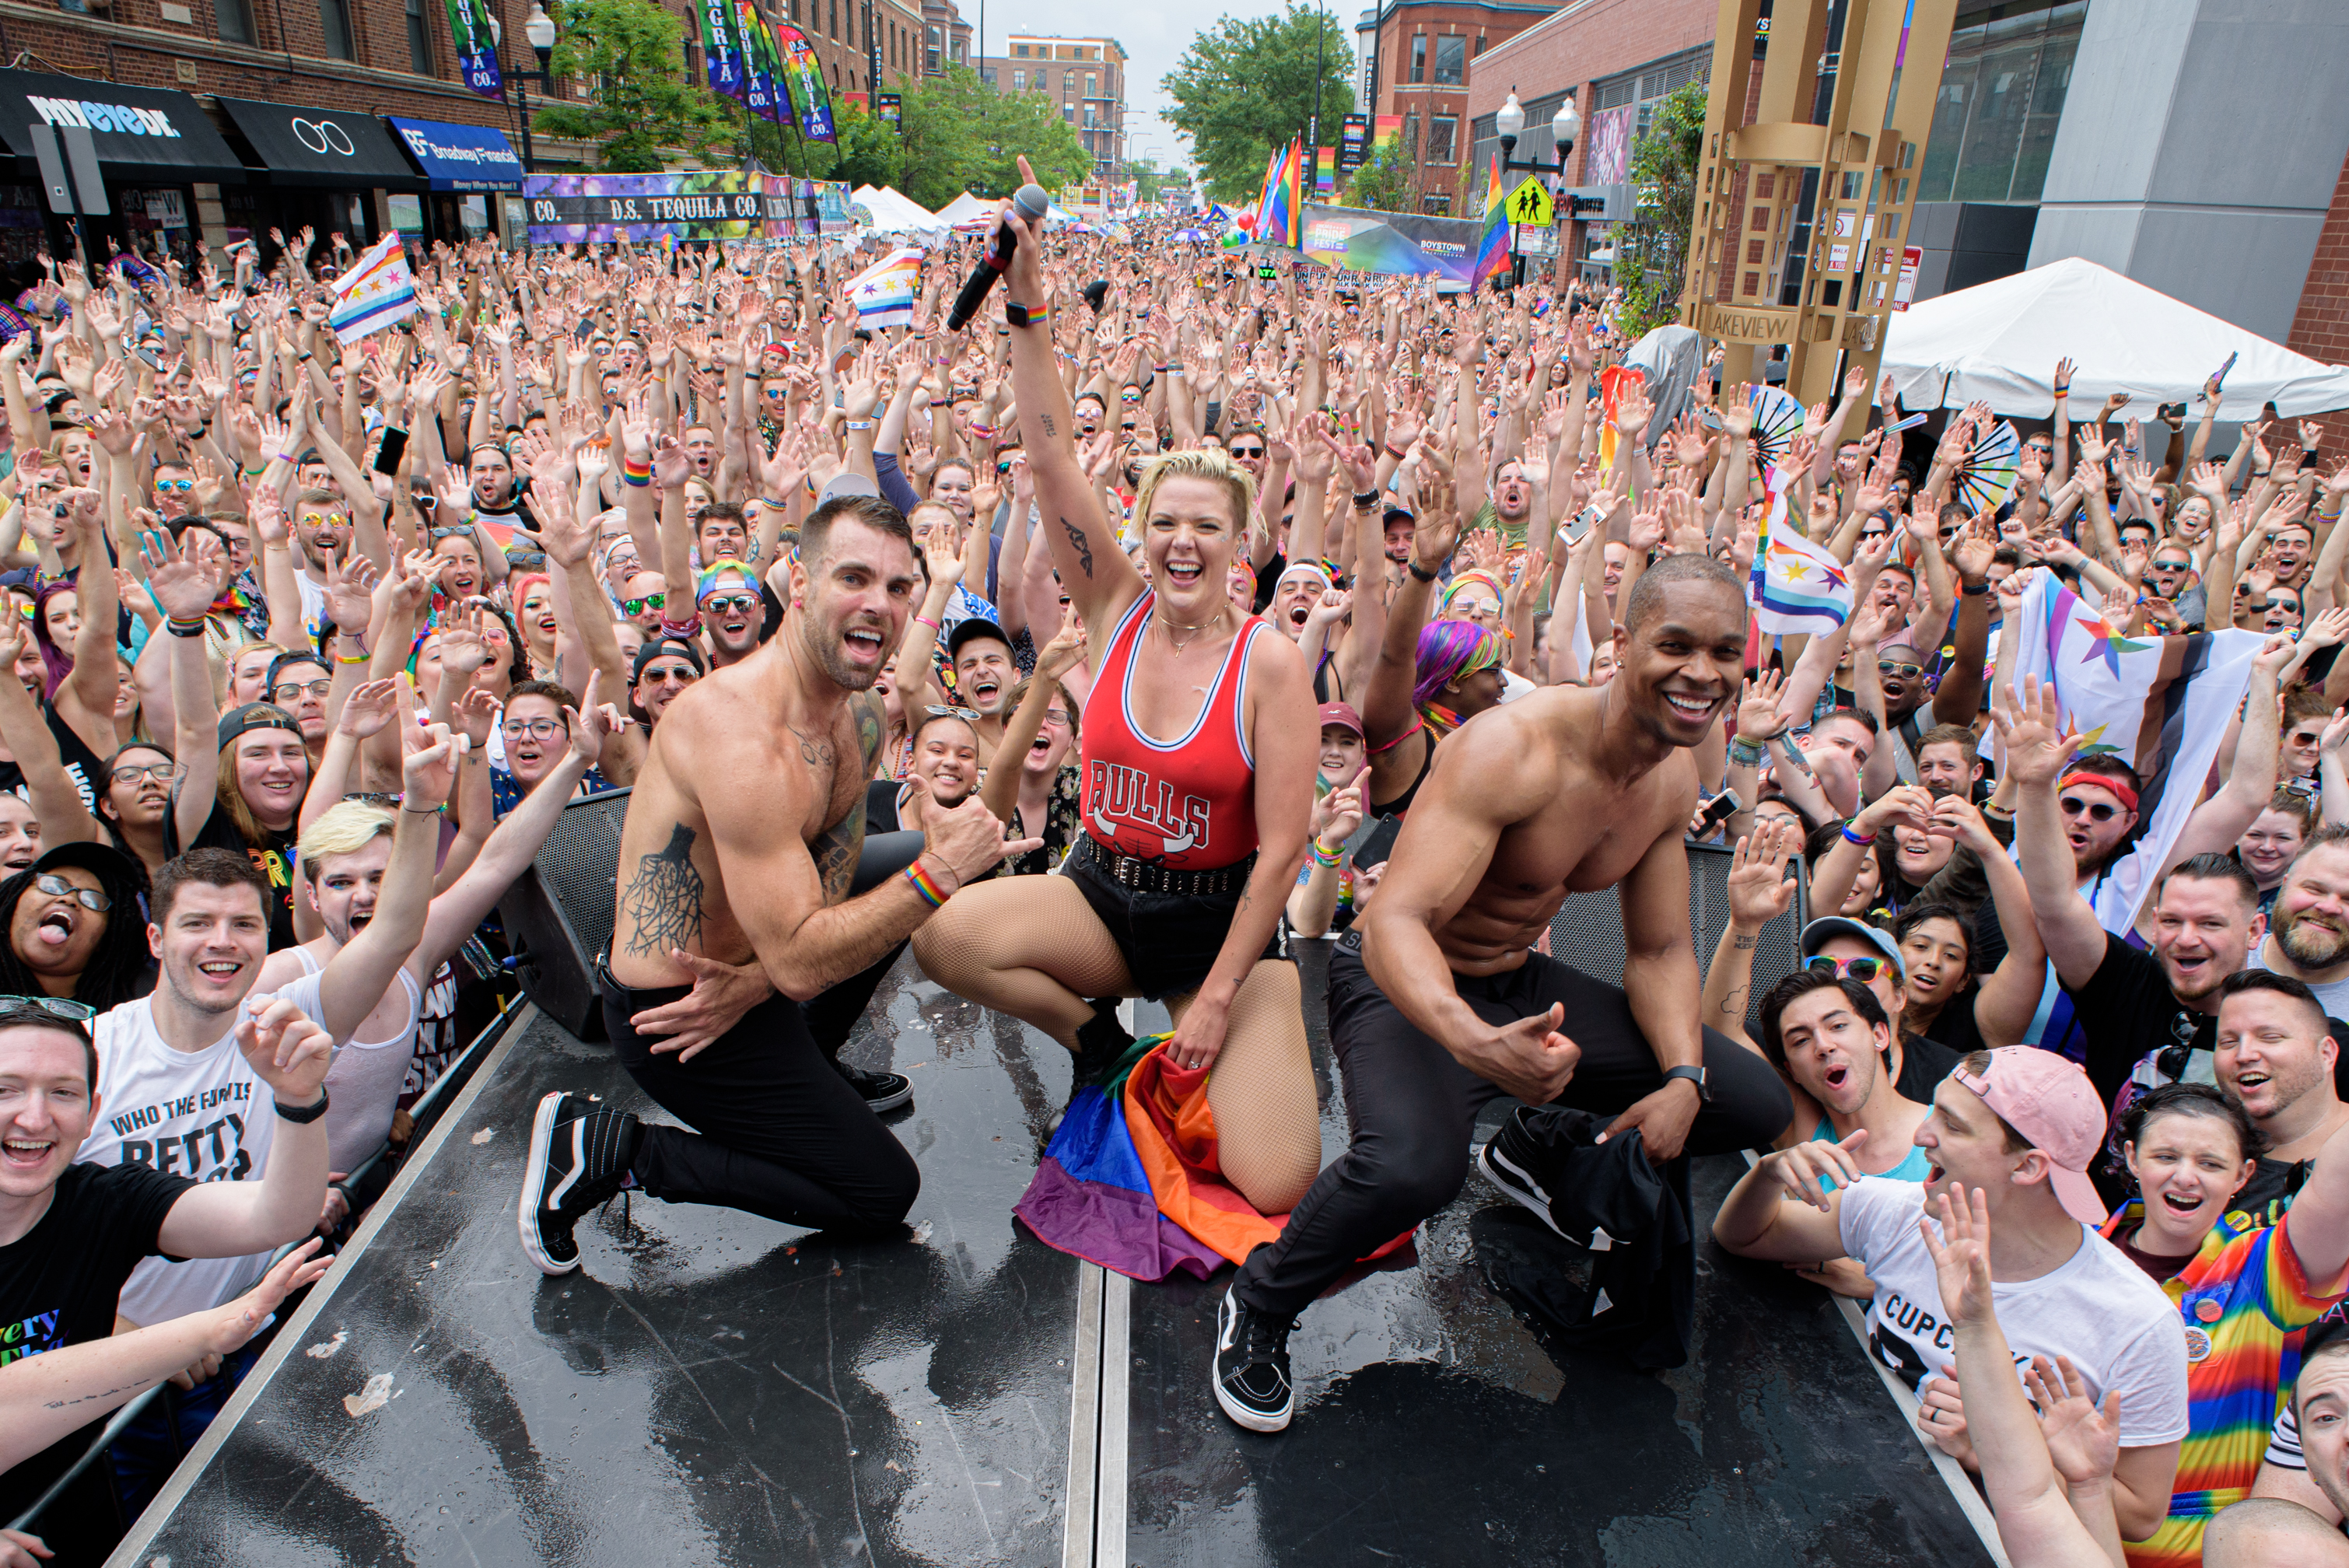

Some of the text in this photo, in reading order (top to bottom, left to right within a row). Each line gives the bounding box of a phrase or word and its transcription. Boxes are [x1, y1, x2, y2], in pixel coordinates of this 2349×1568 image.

[734, 2, 770, 107] TEQUILA CO.
[789, 39, 809, 52] D.S.
[473, 72, 496, 87] CO.
[795, 52, 821, 123] TEQUILA
[1364, 64, 1373, 106] HA3736
[811, 124, 829, 135] CO.
[429, 143, 520, 165] Broadway Financial
[453, 180, 471, 191] Money
[472, 180, 488, 190] When
[488, 181, 498, 190] You
[499, 181, 513, 190] Need
[534, 200, 562, 222] CO.
[611, 199, 642, 220] D.S.
[648, 197, 727, 220] TEQUILA
[735, 196, 761, 217] CO.
[1315, 228, 1346, 240] PRIDE
[1420, 240, 1466, 253] BOYSTOWN
[1836, 261, 1846, 269] YOU
[1709, 311, 1789, 339] LAKEVIEW
[1087, 759, 1210, 849] BULLS
[110, 1104, 161, 1136] WHO
[163, 1095, 197, 1119] THE
[122, 1113, 245, 1176] BETTY
